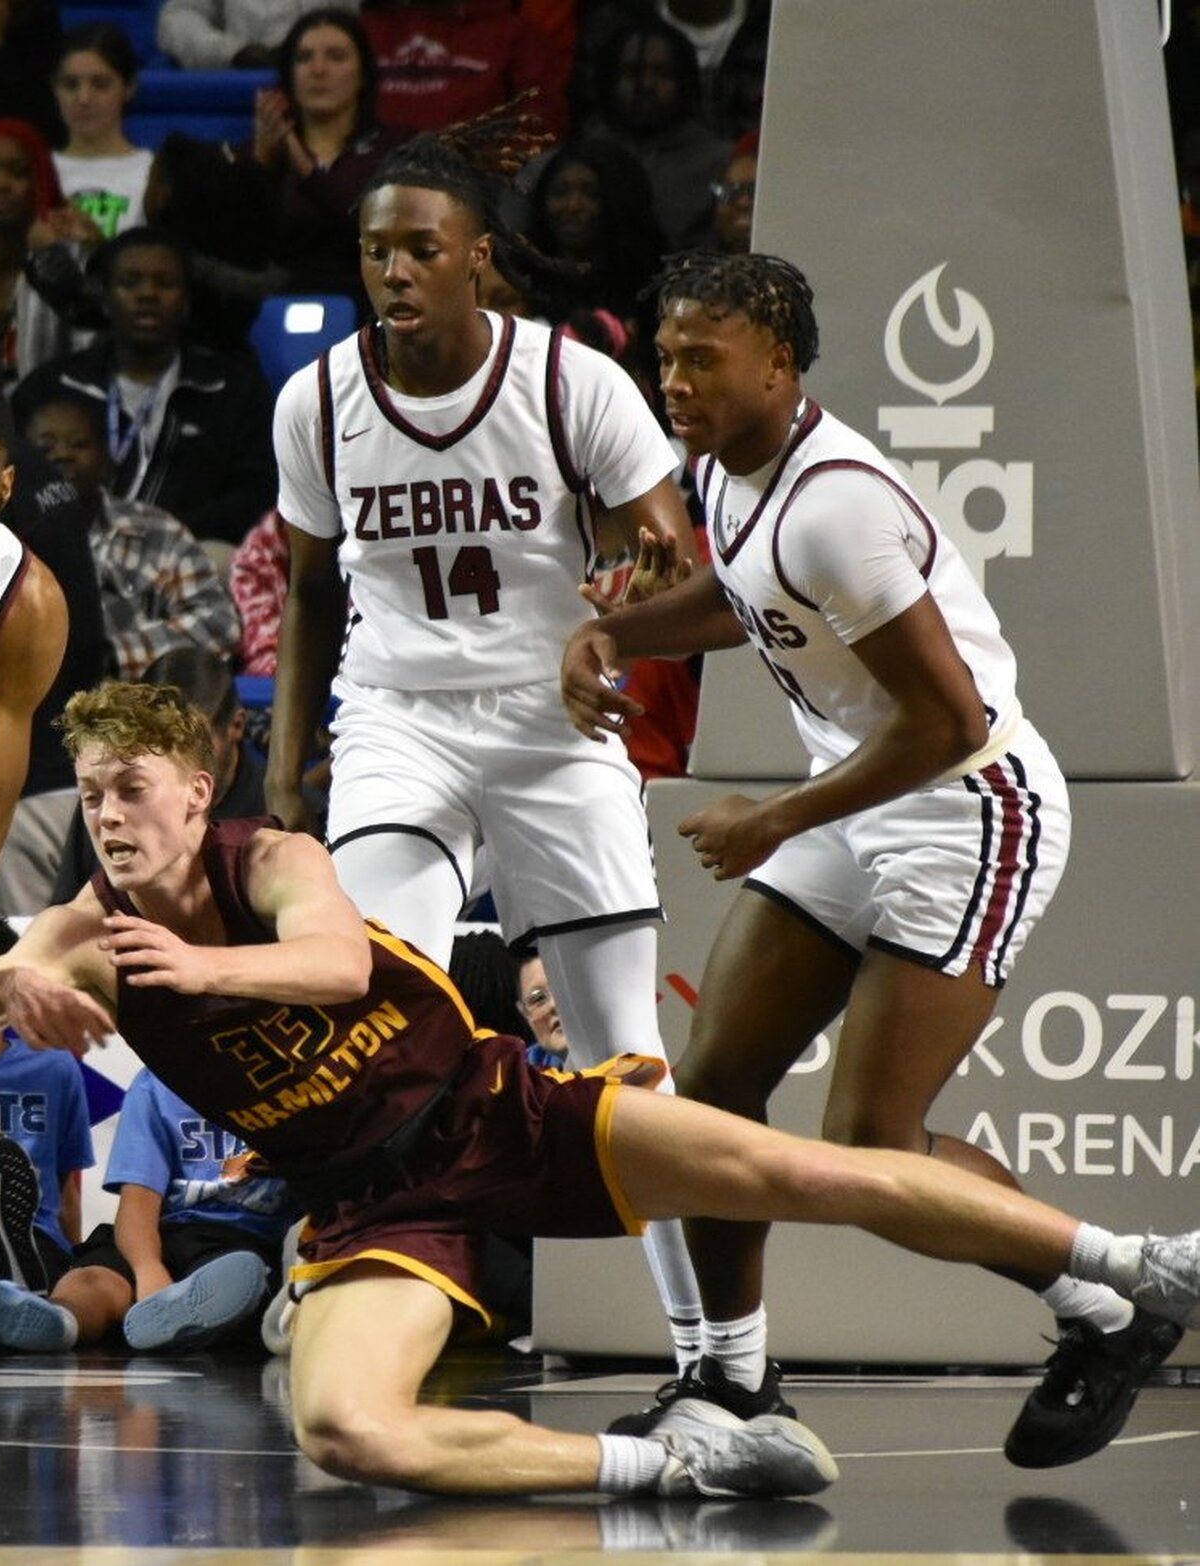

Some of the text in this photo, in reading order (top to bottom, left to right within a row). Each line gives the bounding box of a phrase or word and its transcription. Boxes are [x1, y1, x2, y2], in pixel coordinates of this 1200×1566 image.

[349, 475, 542, 541] ZEBRAS
[411, 545, 501, 620] 14
[226, 1001, 410, 1132] HAMILTON
